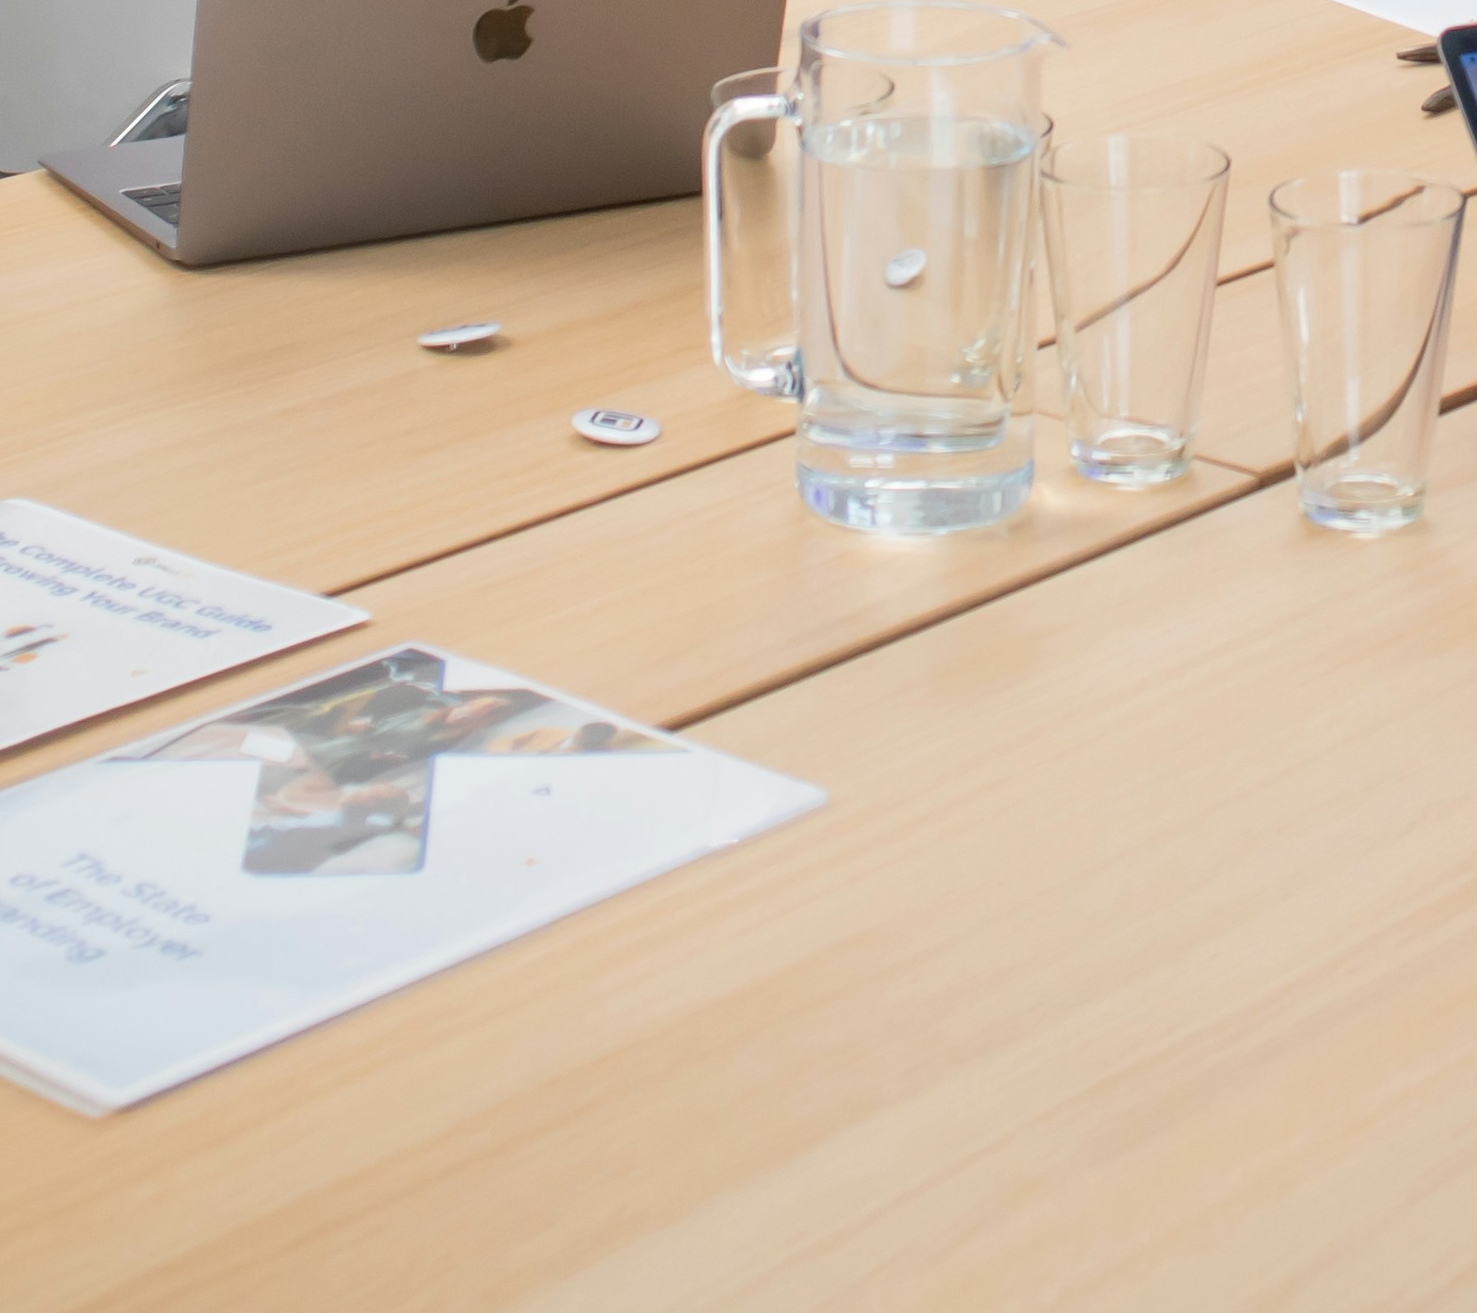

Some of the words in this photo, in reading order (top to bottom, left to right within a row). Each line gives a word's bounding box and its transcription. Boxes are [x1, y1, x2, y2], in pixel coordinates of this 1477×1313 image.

[19, 544, 139, 593] Complete
[138, 586, 202, 613] UGC
[196, 605, 274, 635] Guide
[79, 590, 137, 618] Your
[134, 610, 223, 640] Brand
[60, 851, 125, 886] The
[120, 880, 213, 927] State
